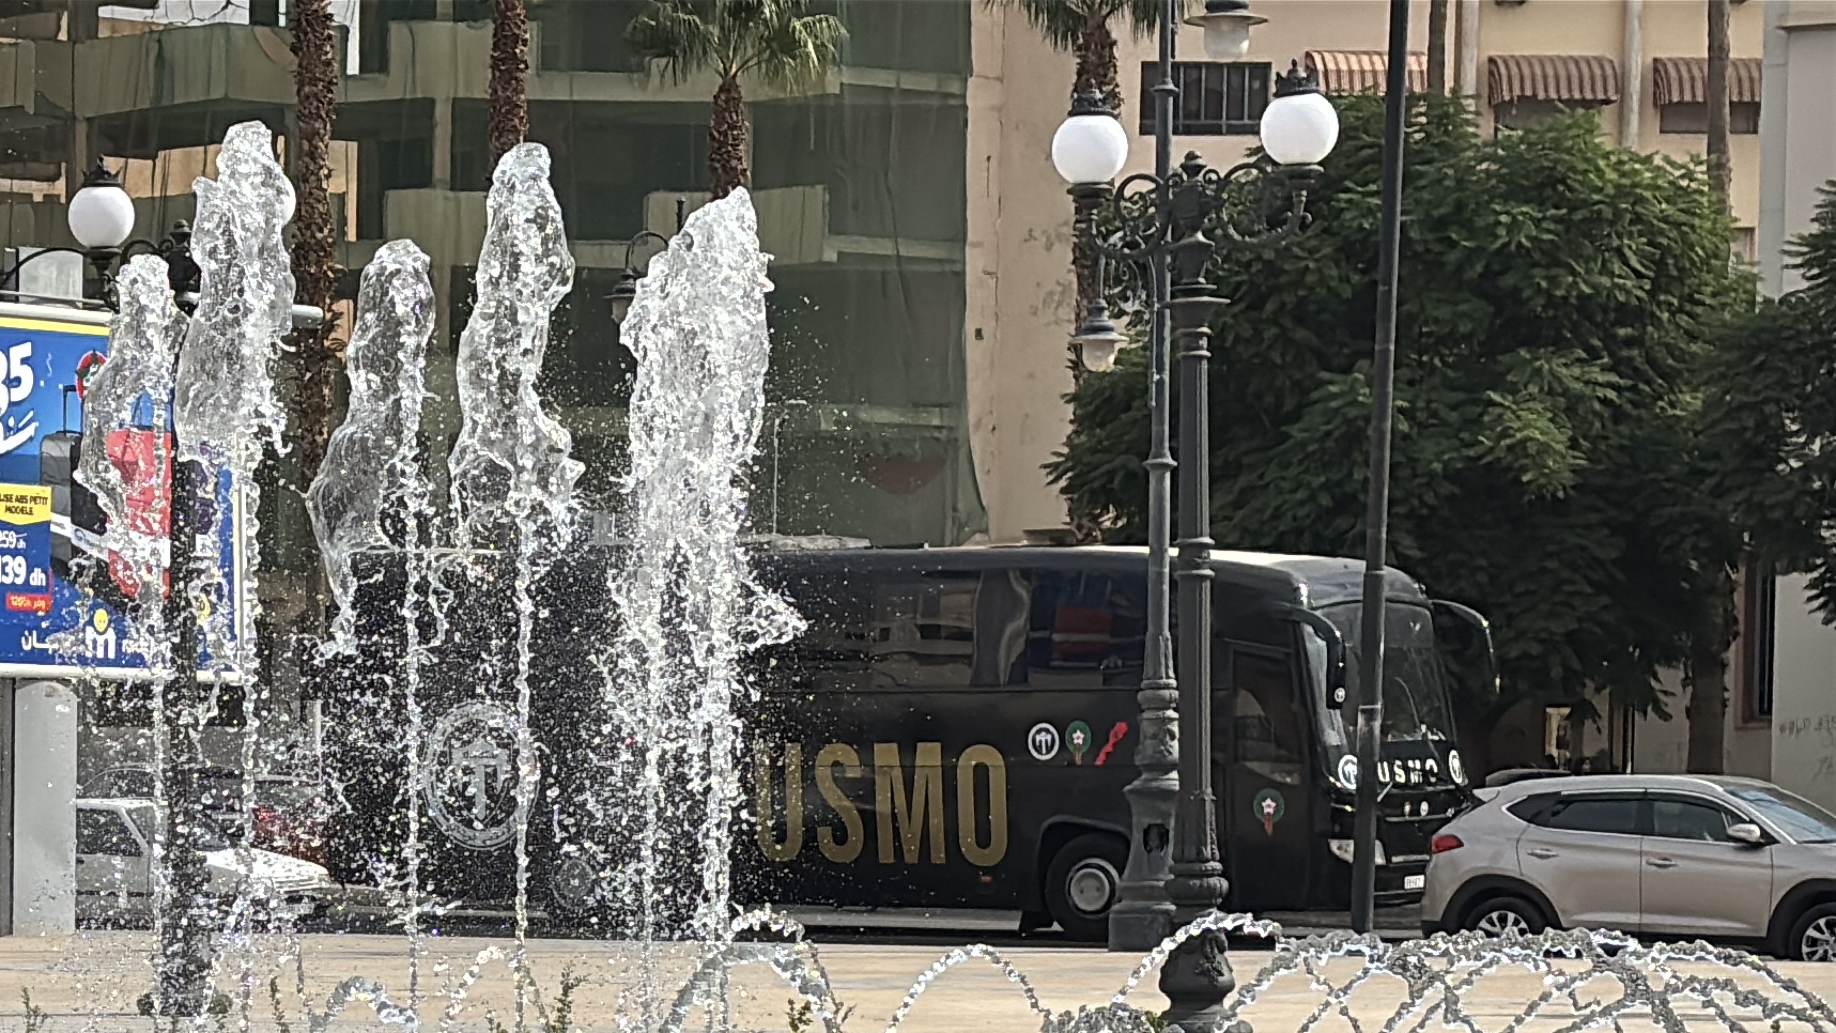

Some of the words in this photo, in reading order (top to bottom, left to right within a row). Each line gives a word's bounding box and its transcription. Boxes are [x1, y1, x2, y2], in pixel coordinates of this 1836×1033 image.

[15, 494, 28, 505] ABS
[29, 495, 48, 506] PETIT
[16, 539, 26, 549] dh
[29, 567, 46, 587] dh
[754, 741, 1008, 867] USMO
